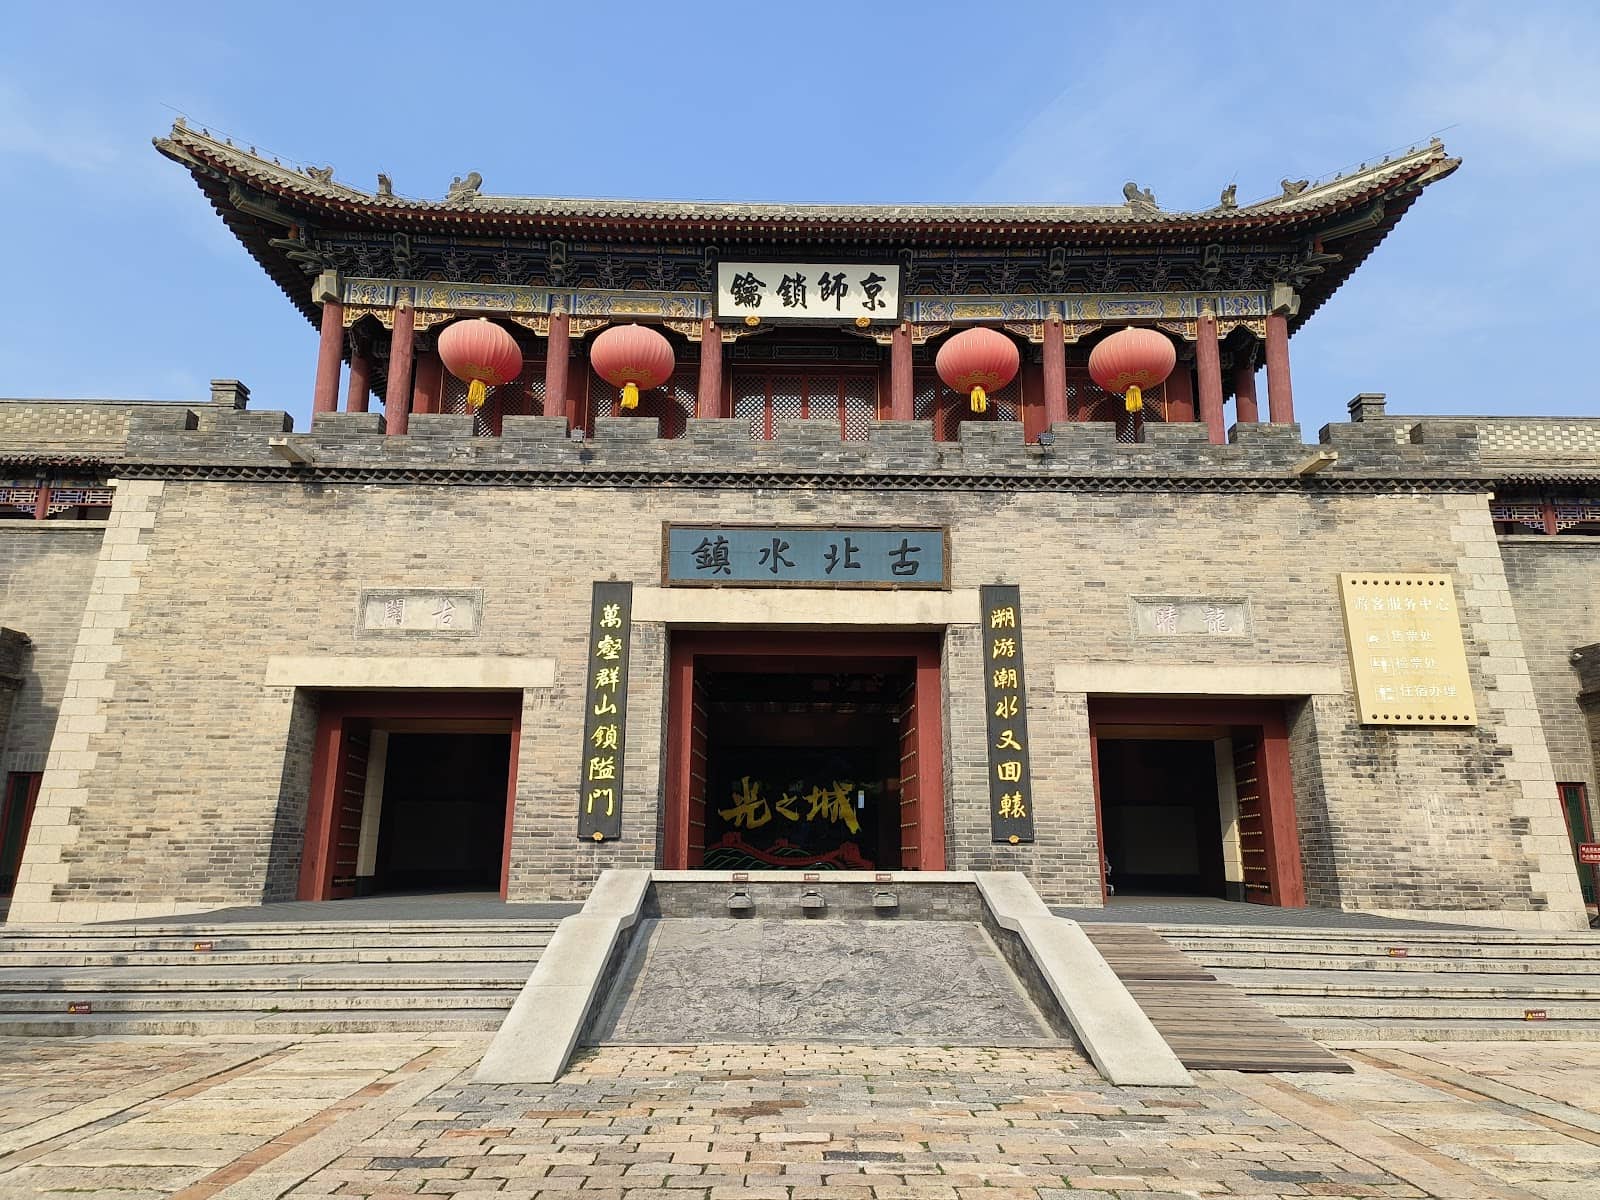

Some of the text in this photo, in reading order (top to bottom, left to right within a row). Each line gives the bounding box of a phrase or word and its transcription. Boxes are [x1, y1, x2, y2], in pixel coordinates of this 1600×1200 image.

[1354, 596, 1449, 611] 游客服务中心
[718, 776, 861, 834] 光之城
